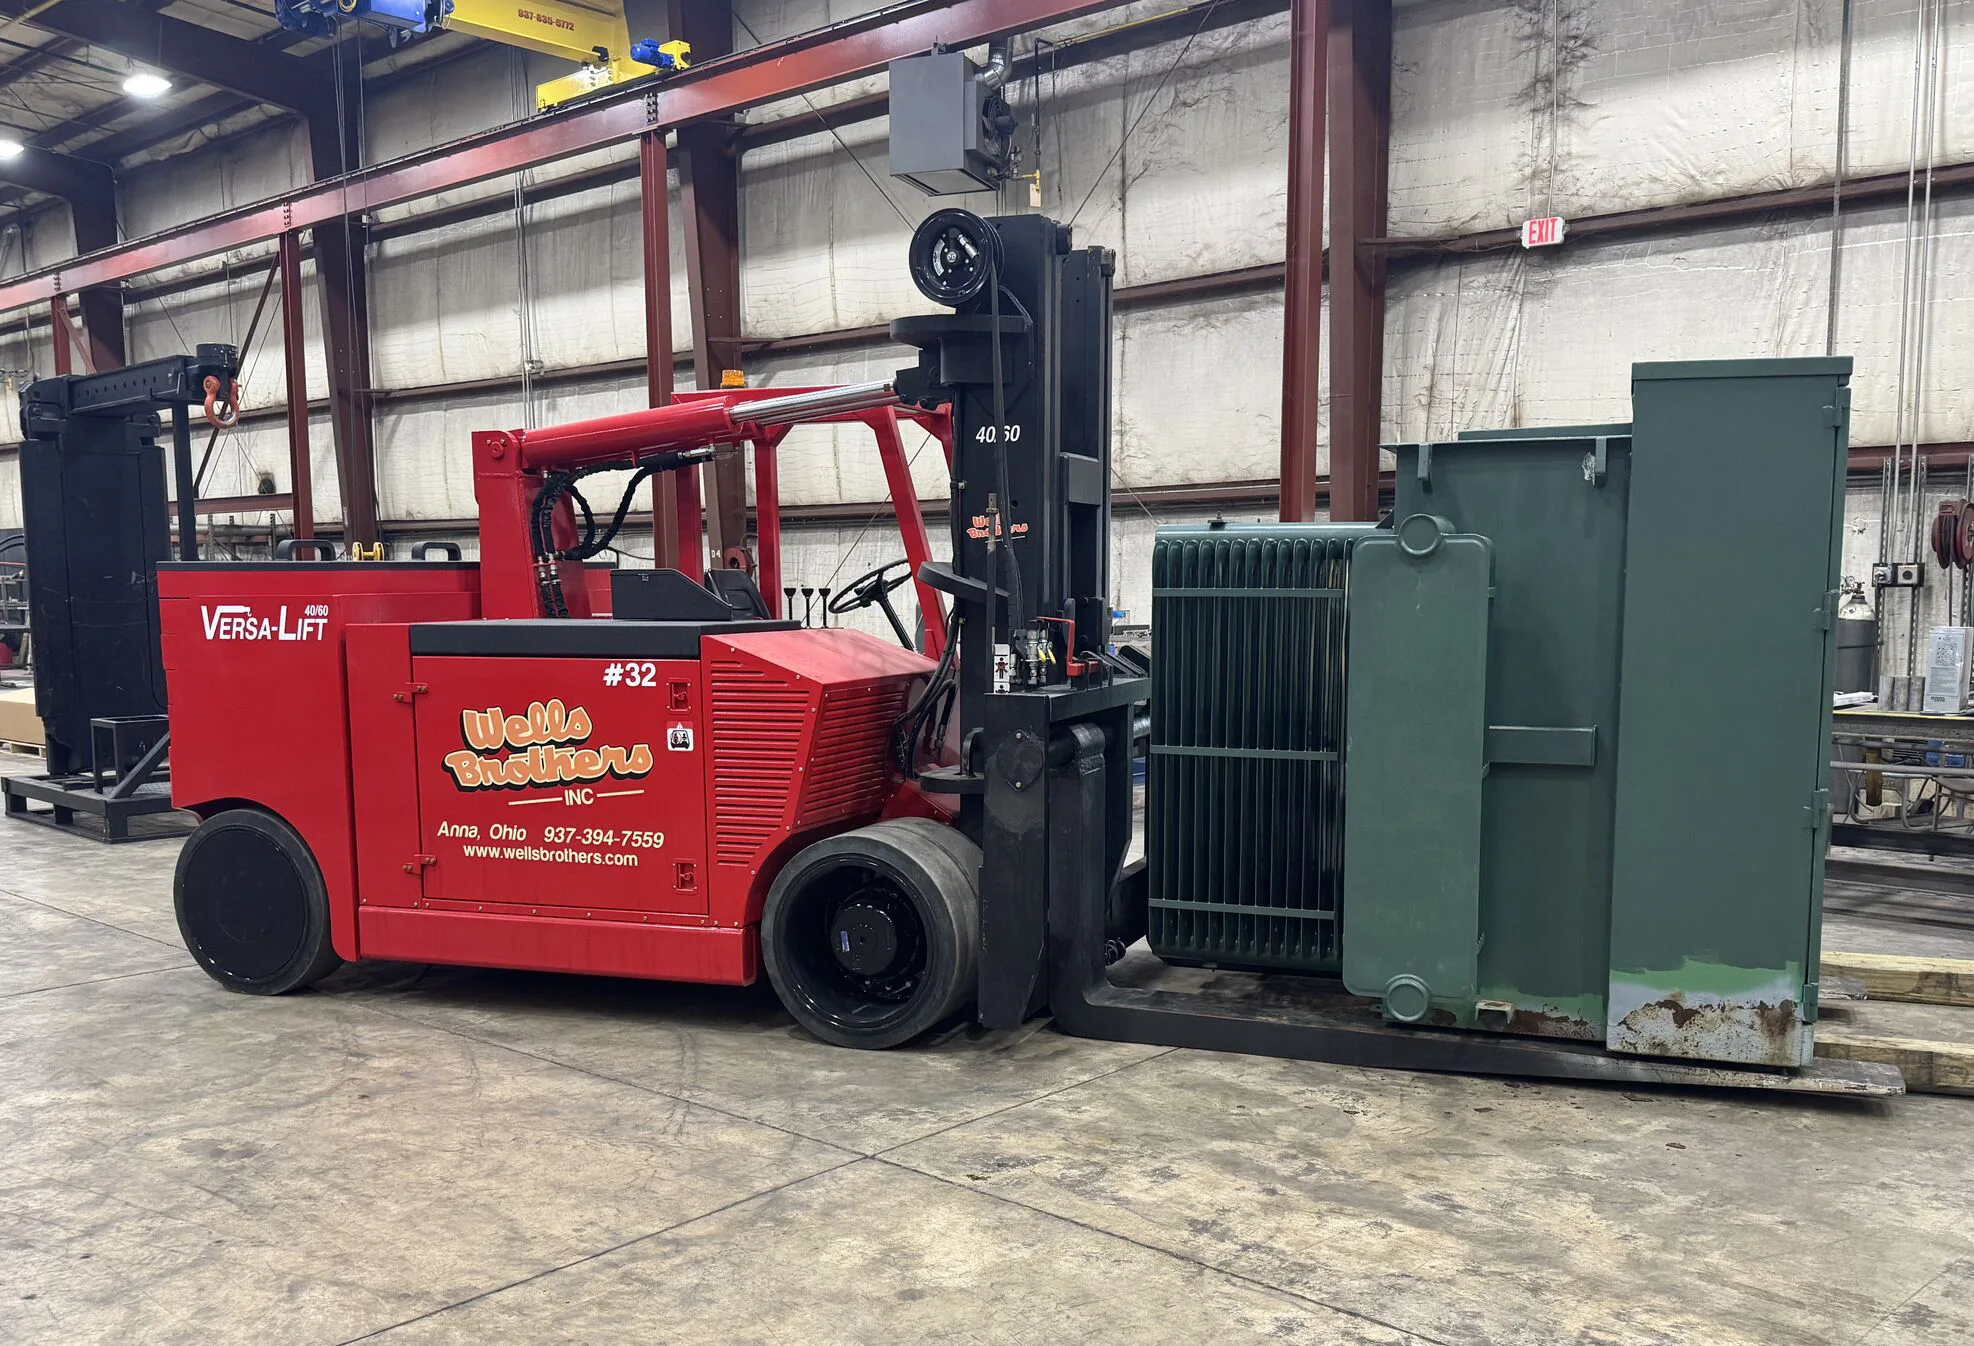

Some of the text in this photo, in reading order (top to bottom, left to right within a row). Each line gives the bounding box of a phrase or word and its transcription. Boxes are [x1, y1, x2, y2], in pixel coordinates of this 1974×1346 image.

[1528, 218, 1557, 244] EXIT
[304, 604, 329, 616] 40/60
[603, 662, 657, 687] #32
[462, 699, 593, 750] Wells
[444, 743, 654, 788] Brothers
[564, 788, 595, 806] INC
[437, 820, 665, 849] Anna, Ohio 937-394-7559
[463, 845, 638, 867] www.wellsbrothers.com
